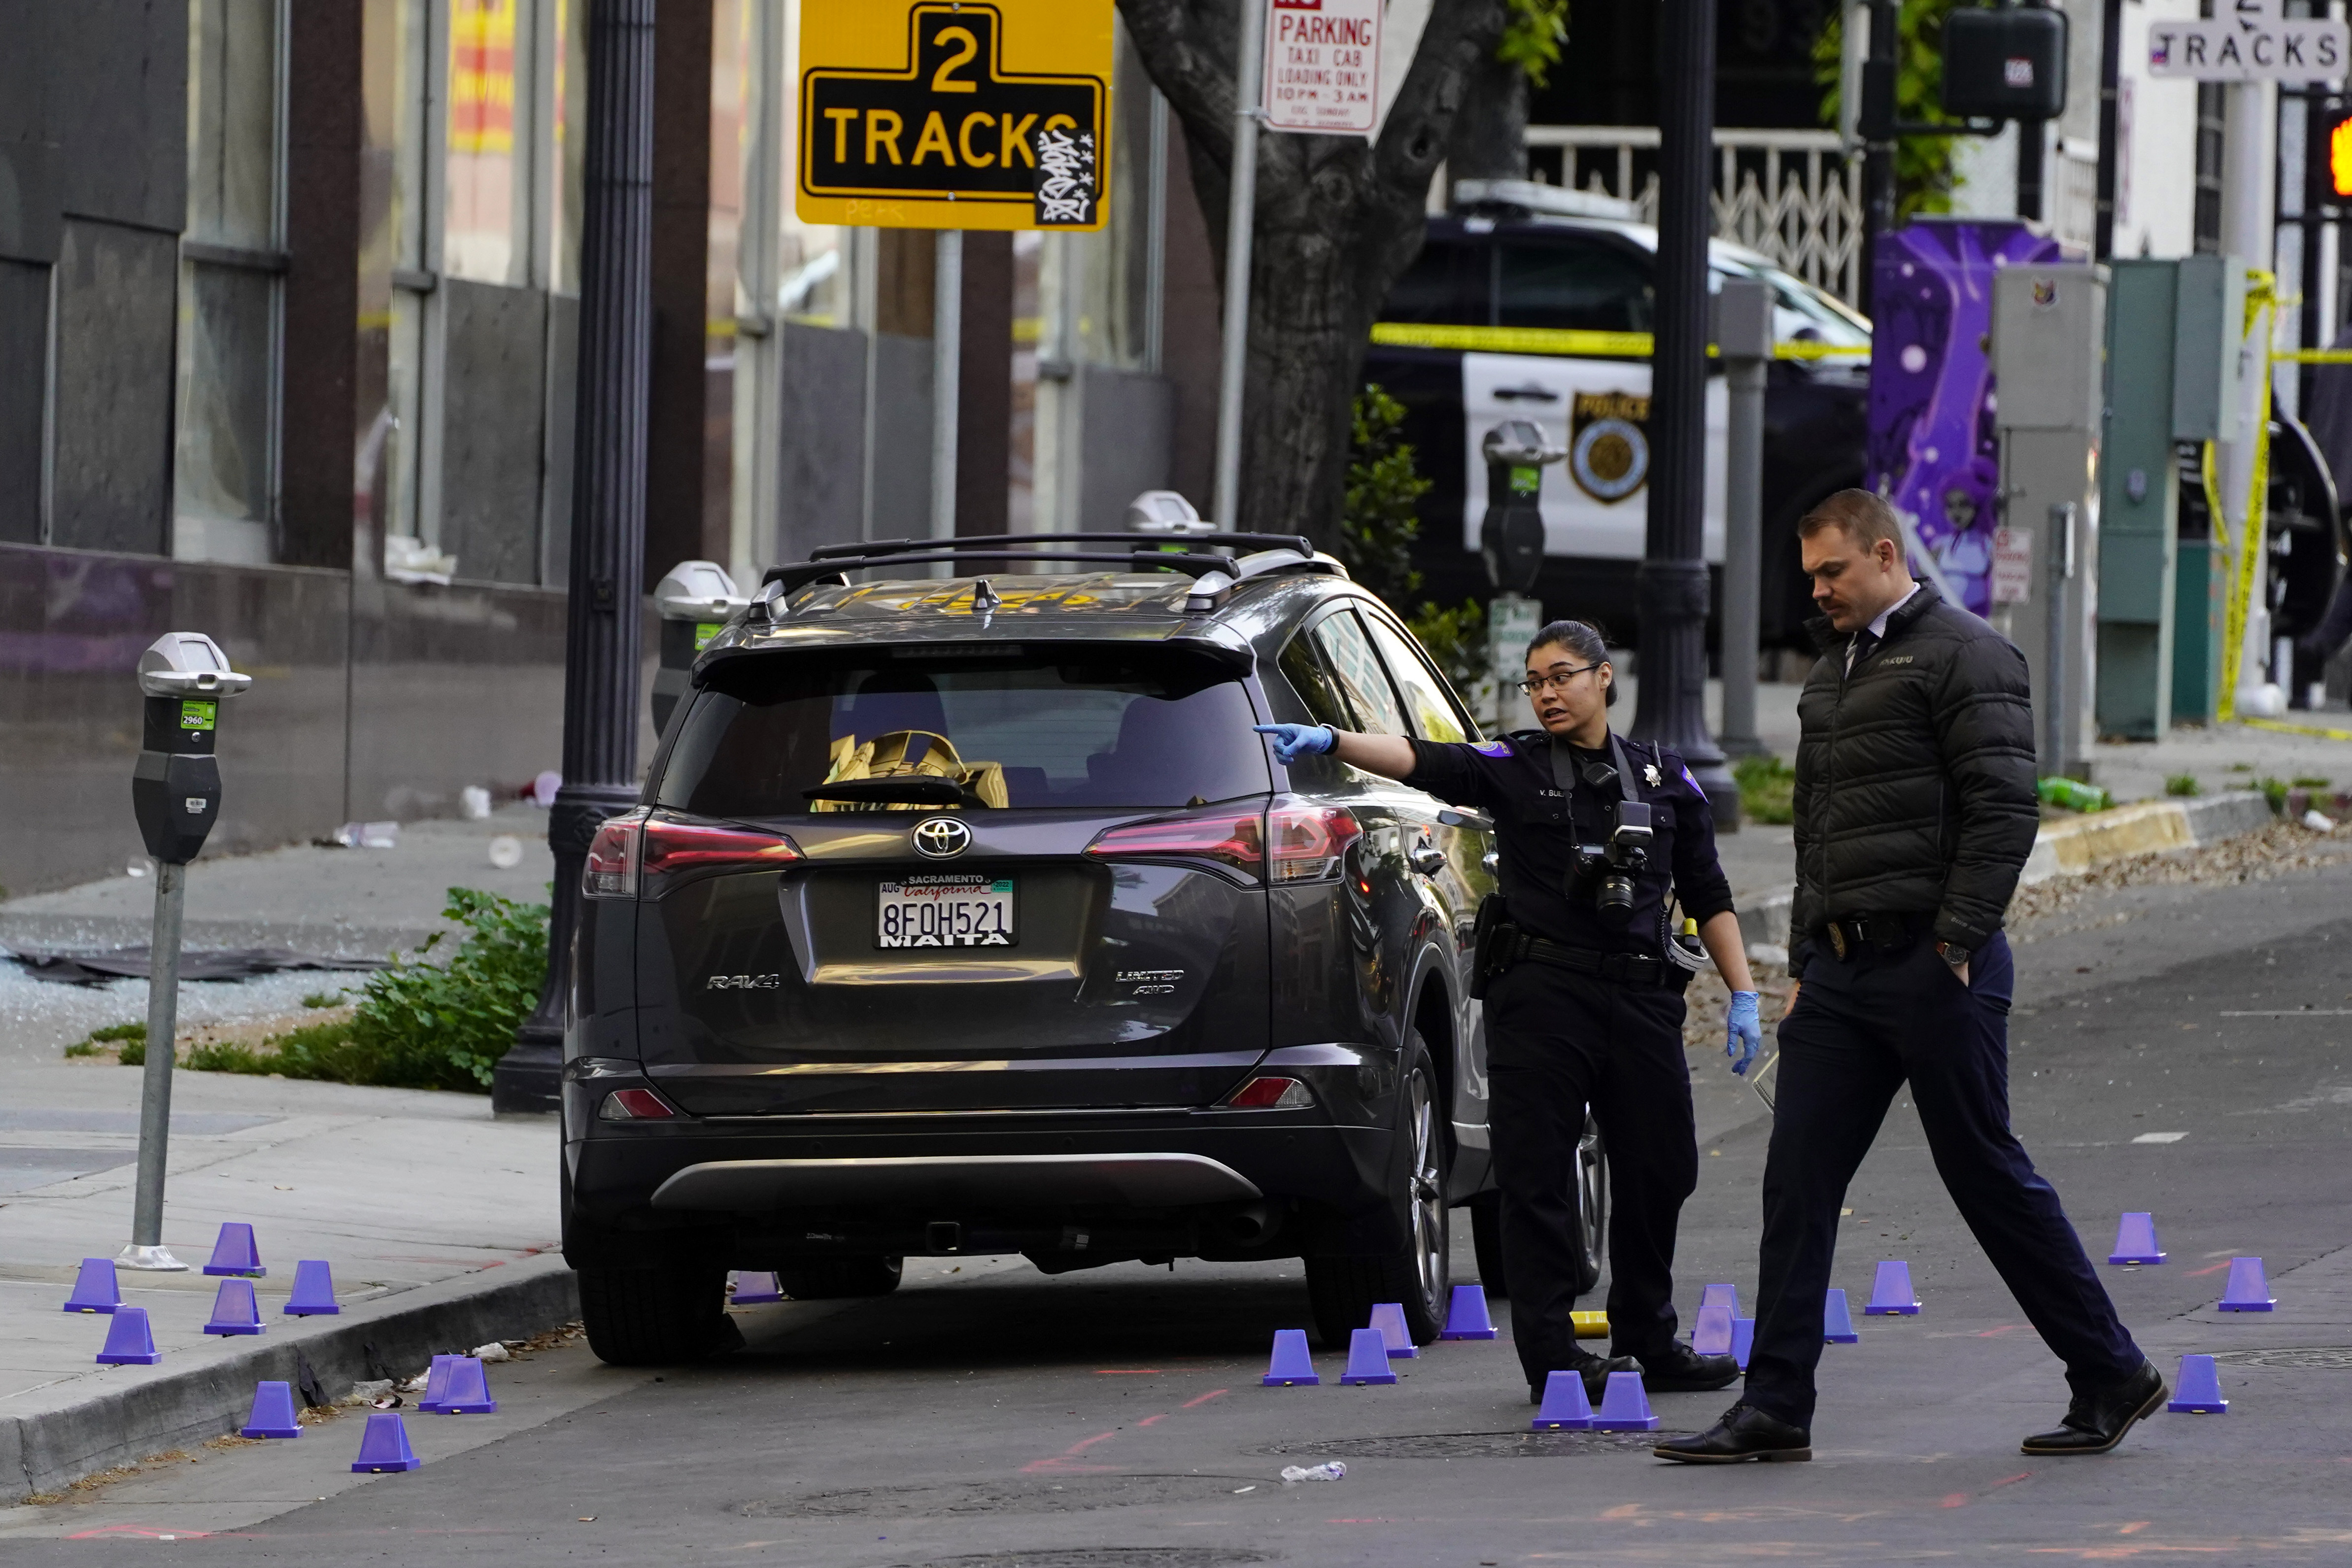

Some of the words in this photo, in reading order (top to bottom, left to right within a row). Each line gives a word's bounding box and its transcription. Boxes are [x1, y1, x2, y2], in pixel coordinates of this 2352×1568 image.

[1279, 14, 1372, 46] PARKING
[1333, 49, 1363, 67] CAB
[2158, 33, 2337, 67] TRACKS
[930, 26, 979, 94] 2
[183, 716, 203, 724] 2960
[1548, 789, 1572, 798] BUE
[908, 875, 984, 885] SACRAMENTO
[881, 884, 900, 893] AUG
[904, 885, 991, 901] California
[880, 934, 1010, 948] MAITA
[706, 973, 780, 989] RAV4
